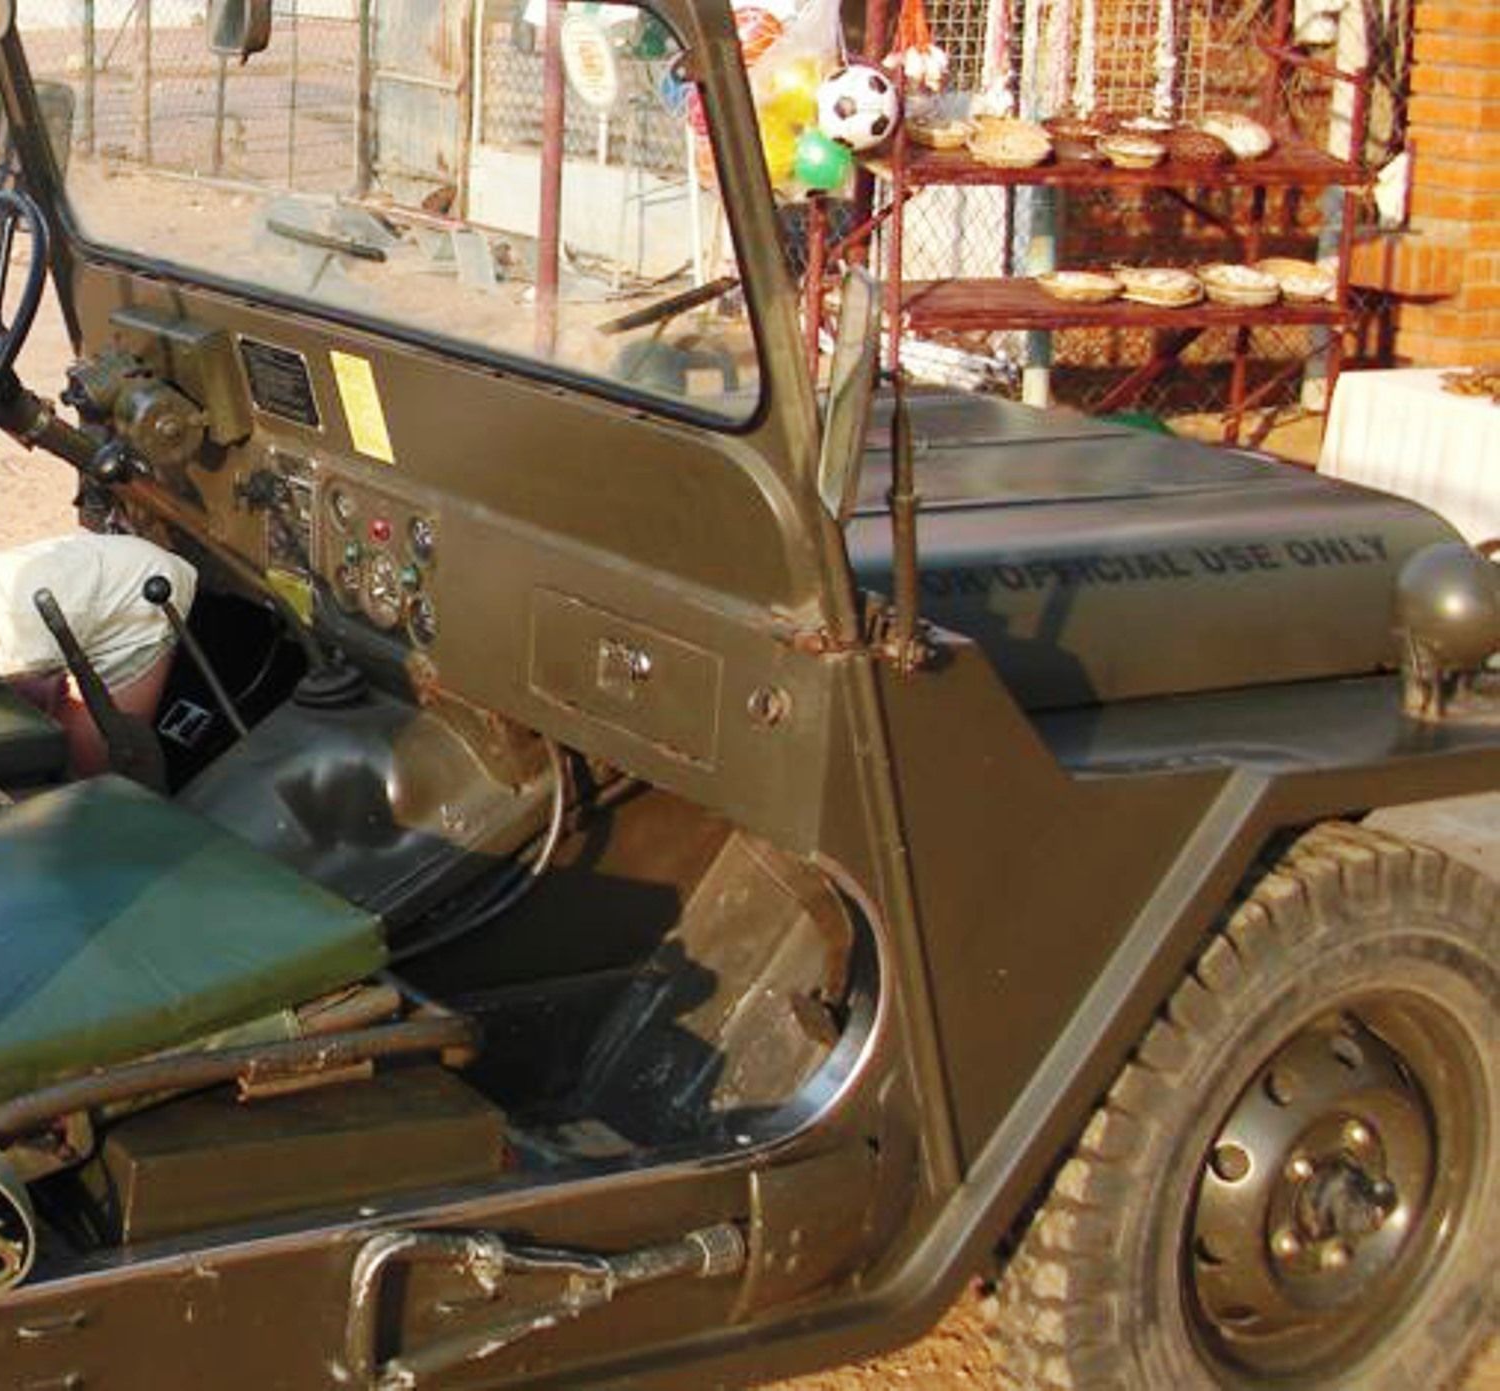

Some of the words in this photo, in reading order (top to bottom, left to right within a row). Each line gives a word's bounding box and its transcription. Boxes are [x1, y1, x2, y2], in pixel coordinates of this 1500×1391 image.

[915, 565, 991, 596] OR
[996, 550, 1192, 590] OFFICIAL
[1195, 545, 1281, 573] USE
[1284, 535, 1387, 567] ONLY
